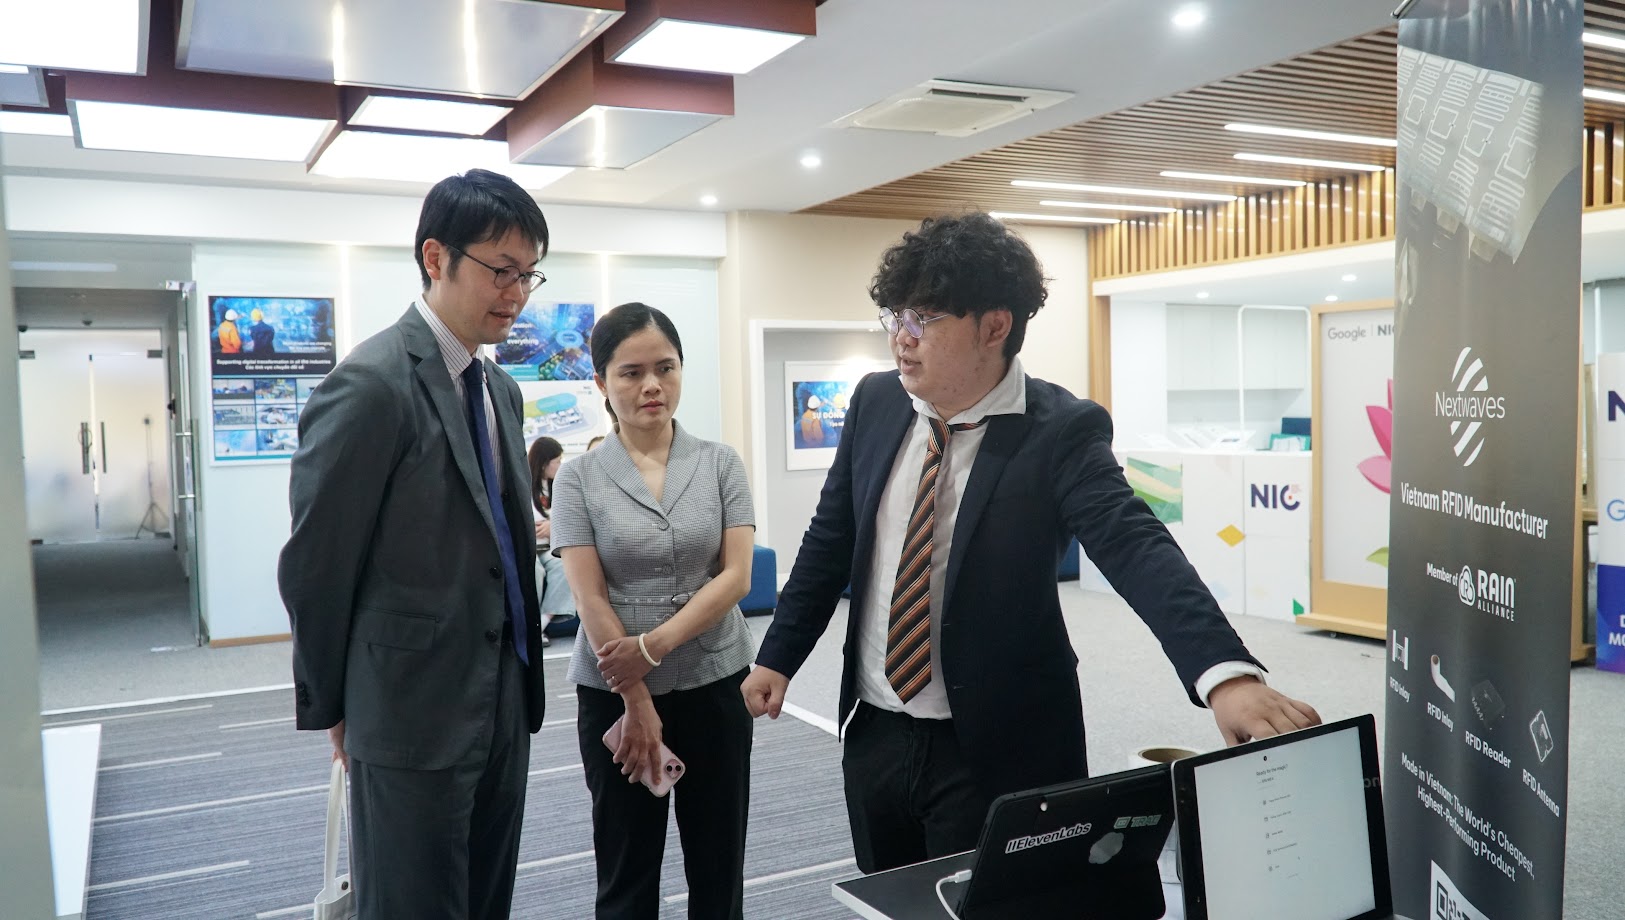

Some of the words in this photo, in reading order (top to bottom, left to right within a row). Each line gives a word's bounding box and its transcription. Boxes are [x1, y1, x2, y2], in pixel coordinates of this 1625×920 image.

[1328, 325, 1366, 341] Google
[1436, 391, 1505, 418] Nextwaves
[1251, 484, 1300, 511] NIC
[1401, 482, 1439, 511] Vietnam
[1442, 490, 1463, 517] RFID
[1464, 495, 1548, 539] Manufacturer
[1427, 562, 1452, 583] Member
[1453, 573, 1458, 586] of
[1478, 569, 1515, 609] RAIN
[1478, 600, 1514, 621] ALLIANCE
[1427, 702, 1441, 721] RFID
[1442, 710, 1454, 732] Inlay
[1466, 731, 1482, 751] RFID
[1483, 741, 1511, 768] Reader
[1523, 768, 1536, 792] RFID
[1537, 782, 1560, 817] Antenna
[1402, 752, 1418, 776] Made
[1419, 765, 1425, 781] in
[1426, 771, 1453, 806] Vietnam:
[1454, 795, 1464, 817] The
[1465, 806, 1496, 841] World's
[1498, 831, 1535, 880] Cheapest,
[1418, 785, 1480, 856] Highest-Performing
[1481, 841, 1516, 882] Product
